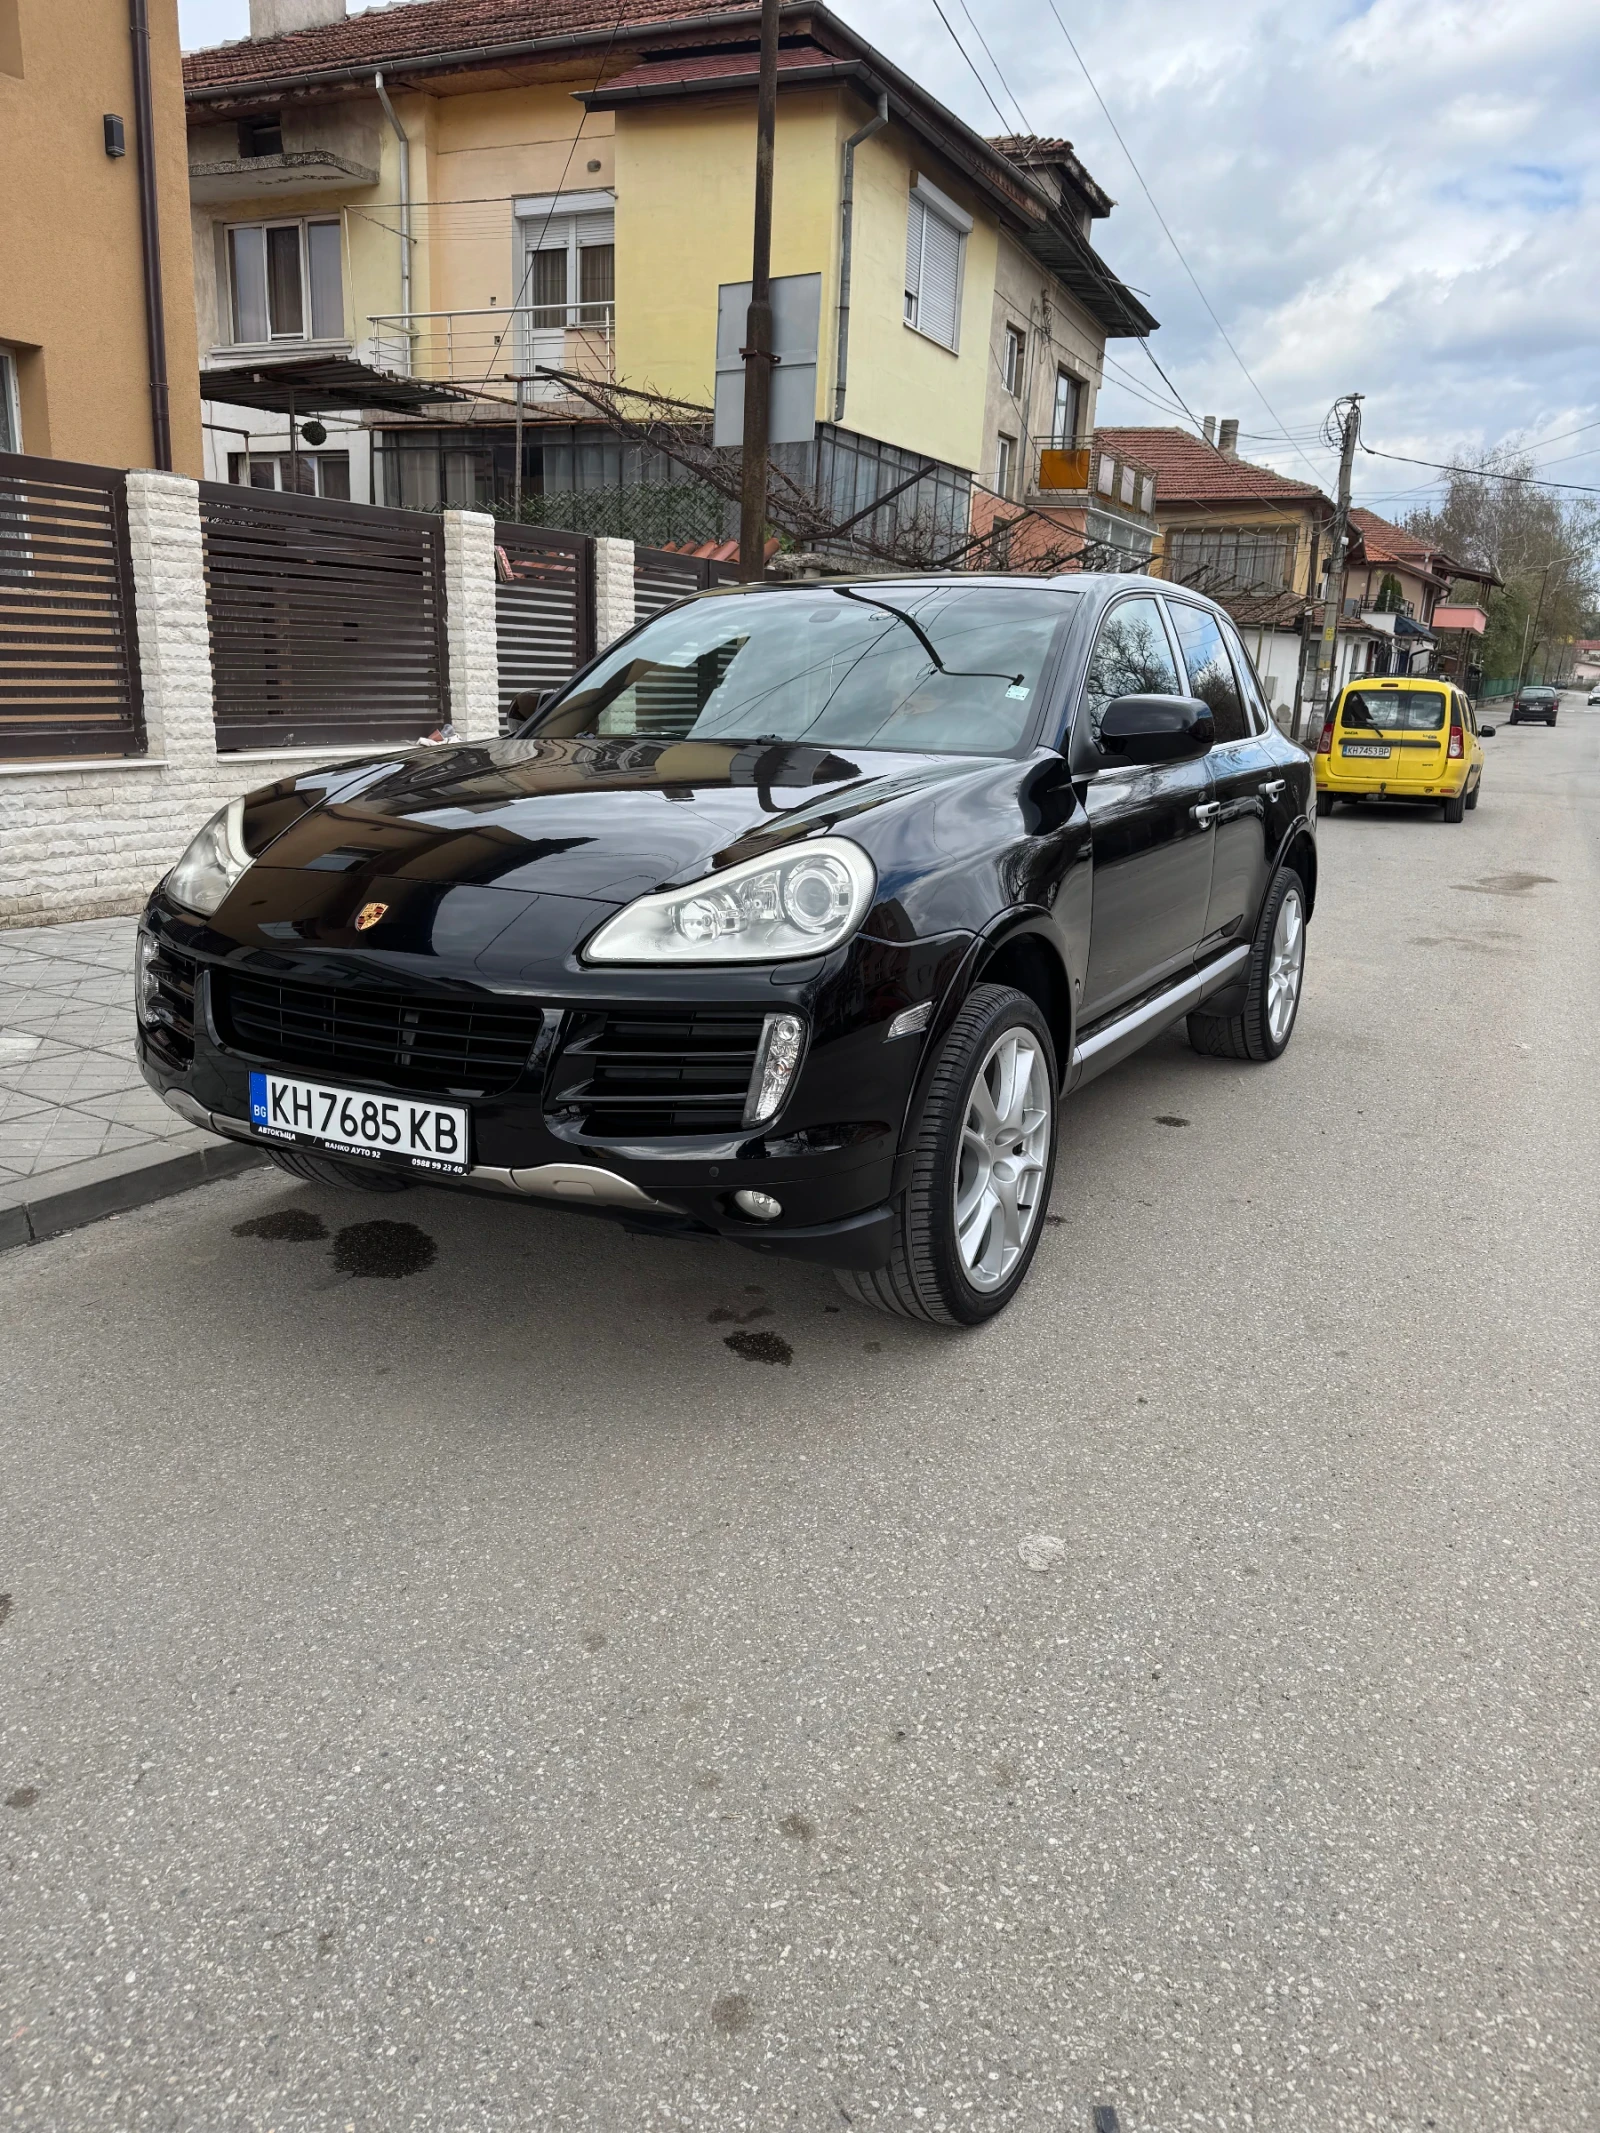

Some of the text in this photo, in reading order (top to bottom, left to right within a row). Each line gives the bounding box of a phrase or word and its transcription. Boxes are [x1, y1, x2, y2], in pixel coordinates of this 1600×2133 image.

[253, 1104, 267, 1117] BG
[258, 1126, 297, 1141] АВТОКЪЩА
[351, 1146, 371, 1157] АУТО
[372, 1150, 381, 1158] 92
[411, 1158, 463, 1174] 0988 99 23 40
